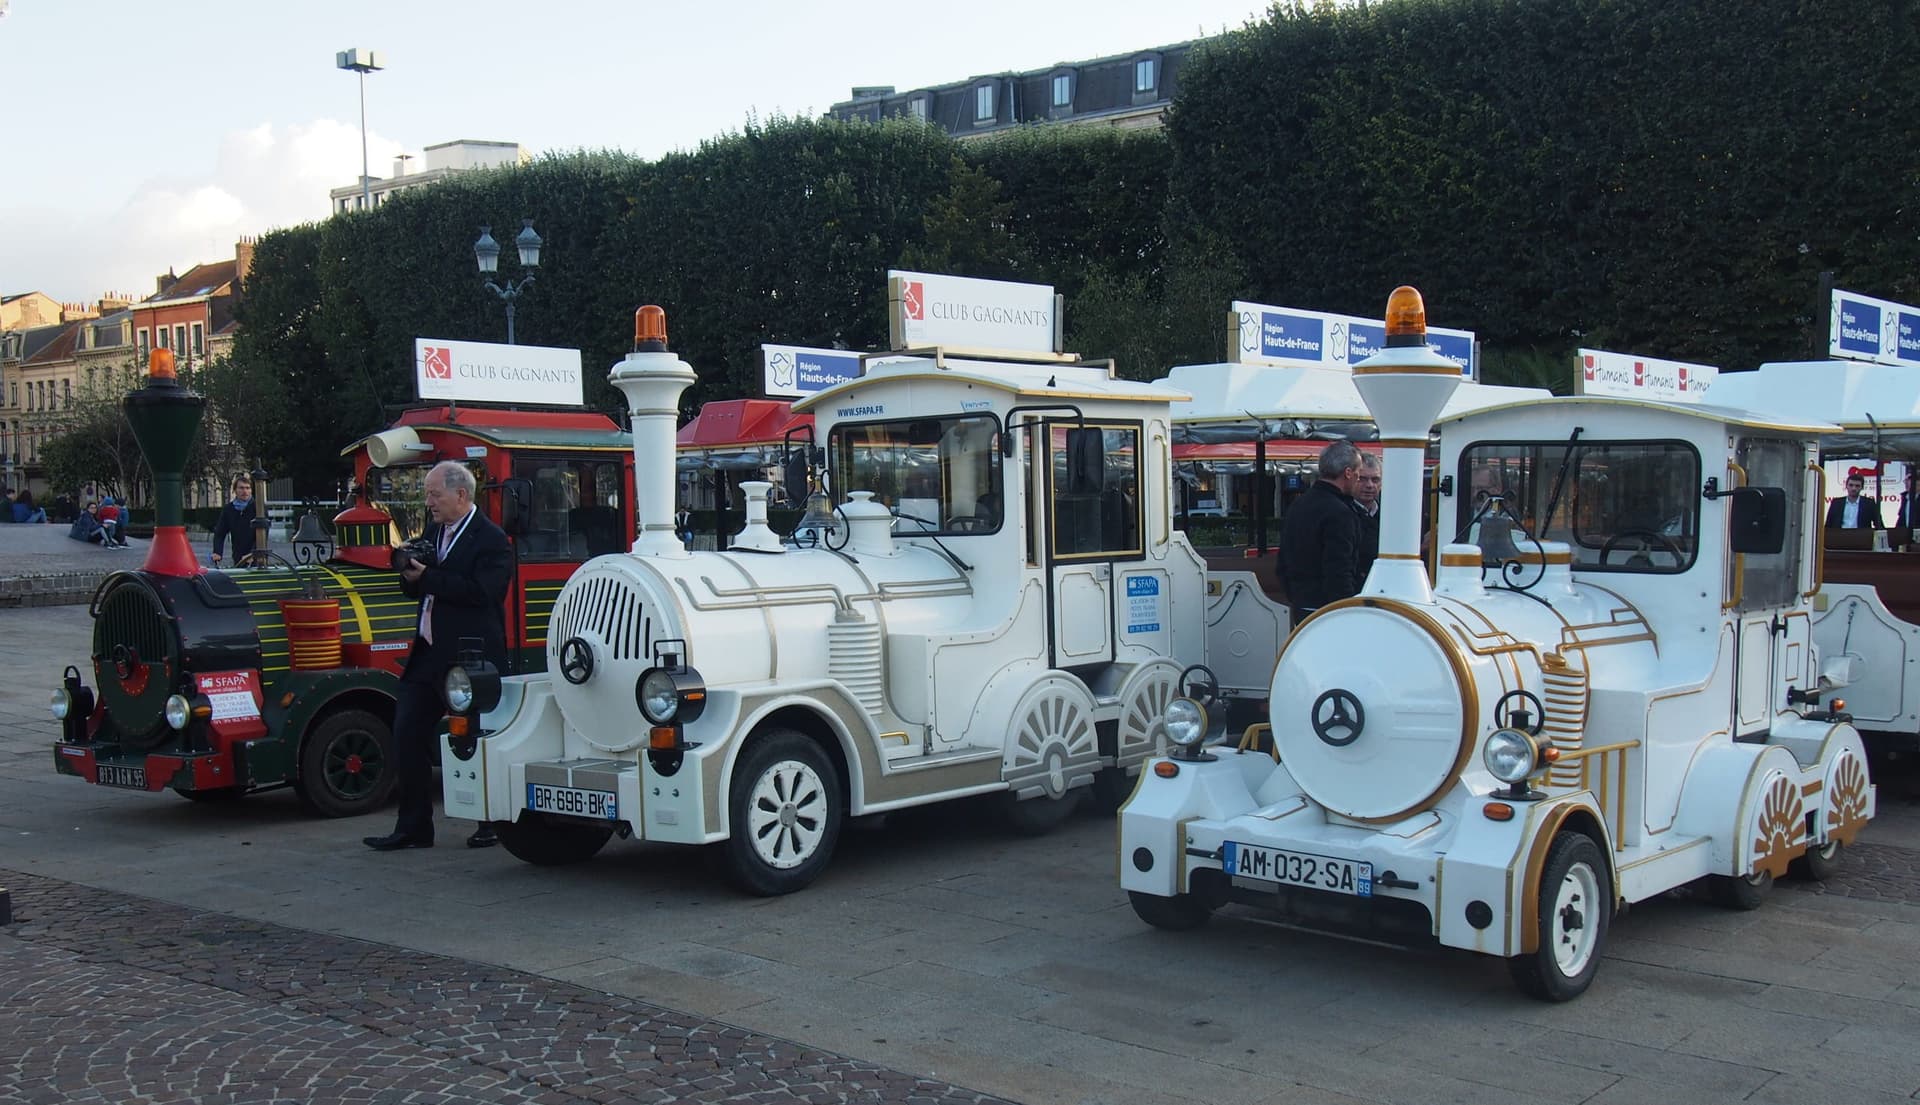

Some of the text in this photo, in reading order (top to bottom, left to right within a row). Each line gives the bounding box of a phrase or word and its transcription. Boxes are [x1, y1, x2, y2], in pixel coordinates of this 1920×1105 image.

[931, 302, 1048, 327] CLUB GAGNANTS
[1264, 322, 1284, 334] Région
[1264, 335, 1320, 351] Hauts-de-France
[459, 363, 576, 384] CLUB GAGNANTS
[799, 362, 822, 372] Région
[837, 405, 884, 418] WWW.SFAPA.FR
[1138, 579, 1158, 588] SFAPA
[215, 676, 247, 688] SFAPA
[535, 787, 607, 816] BR-696-BK
[1240, 848, 1354, 891] AM-032-SA
